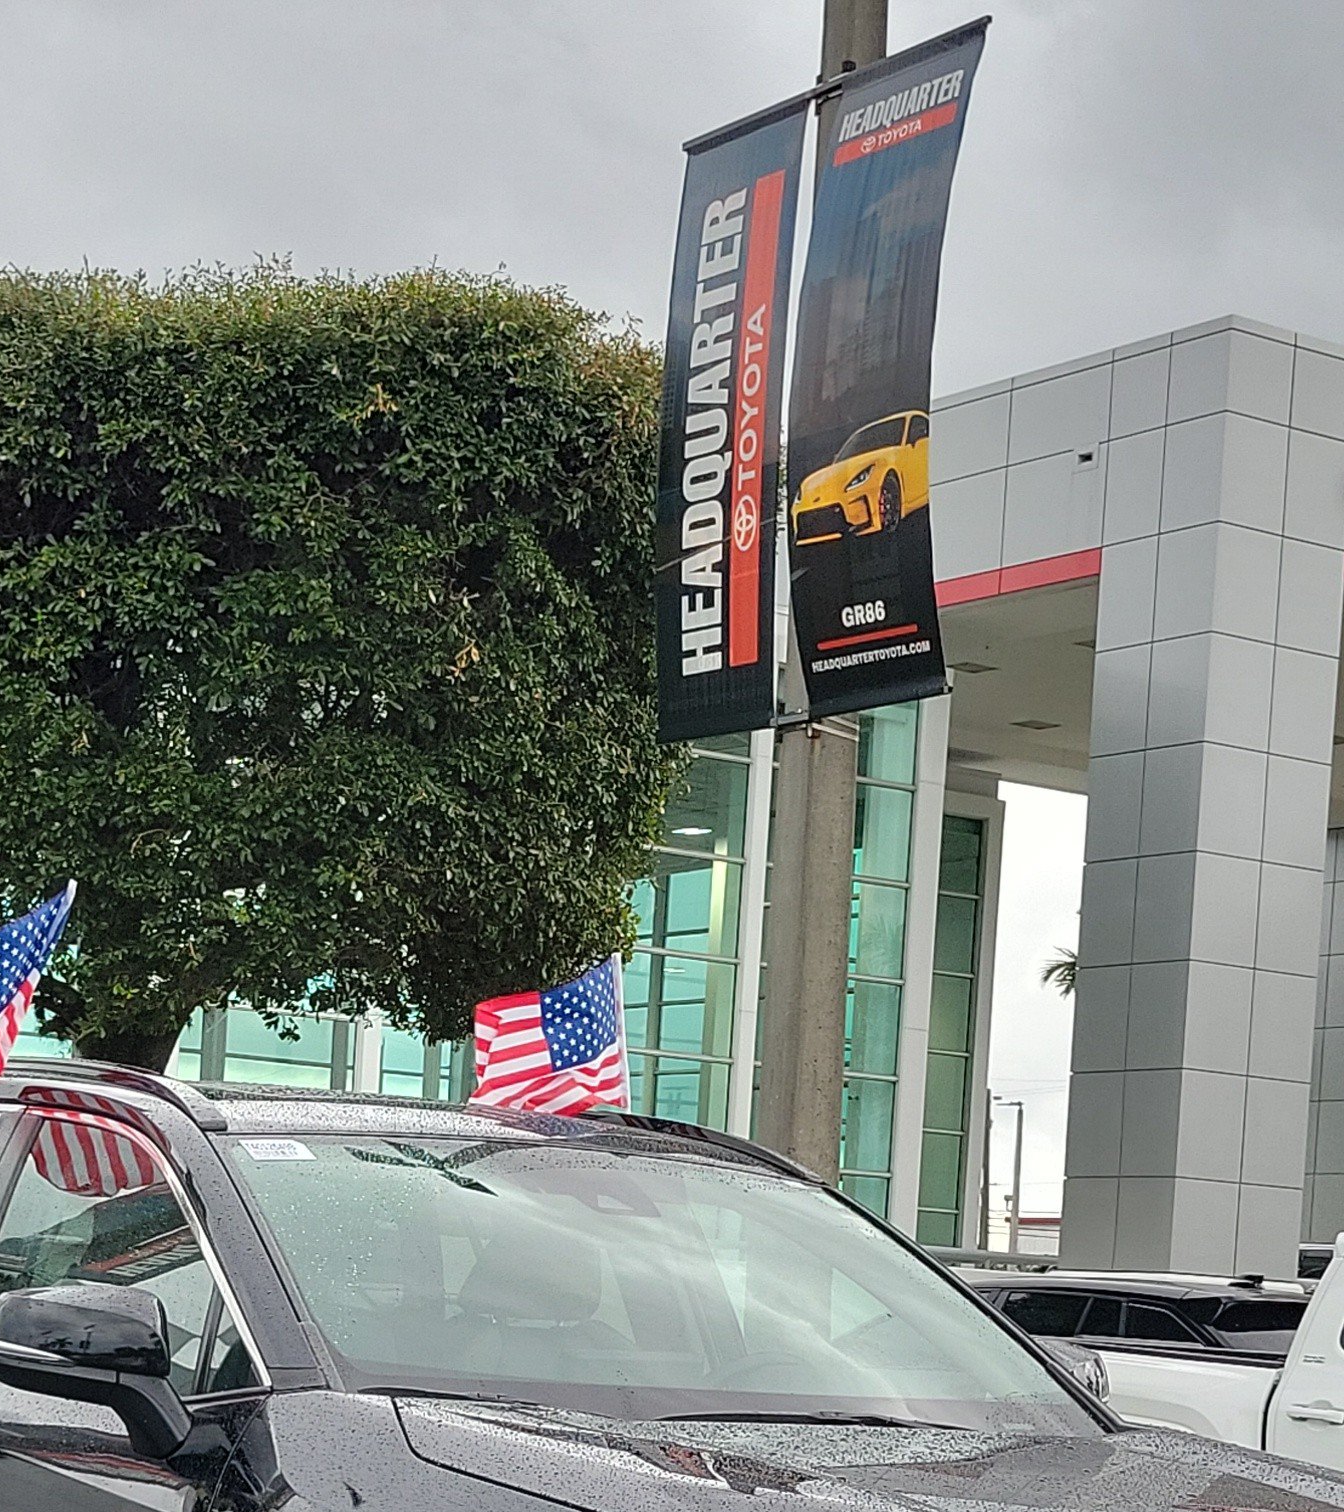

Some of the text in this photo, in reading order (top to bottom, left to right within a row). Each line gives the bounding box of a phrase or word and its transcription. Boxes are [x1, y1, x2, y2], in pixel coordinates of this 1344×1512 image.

[839, 69, 964, 142] HEADQUARTER
[877, 118, 922, 147] TOYOTA
[736, 304, 766, 490] TOYOTA
[681, 187, 749, 677] HEADQUARTER
[841, 600, 886, 628] GR86
[811, 640, 931, 673] HEADQUARTERTOYOTA.COM
